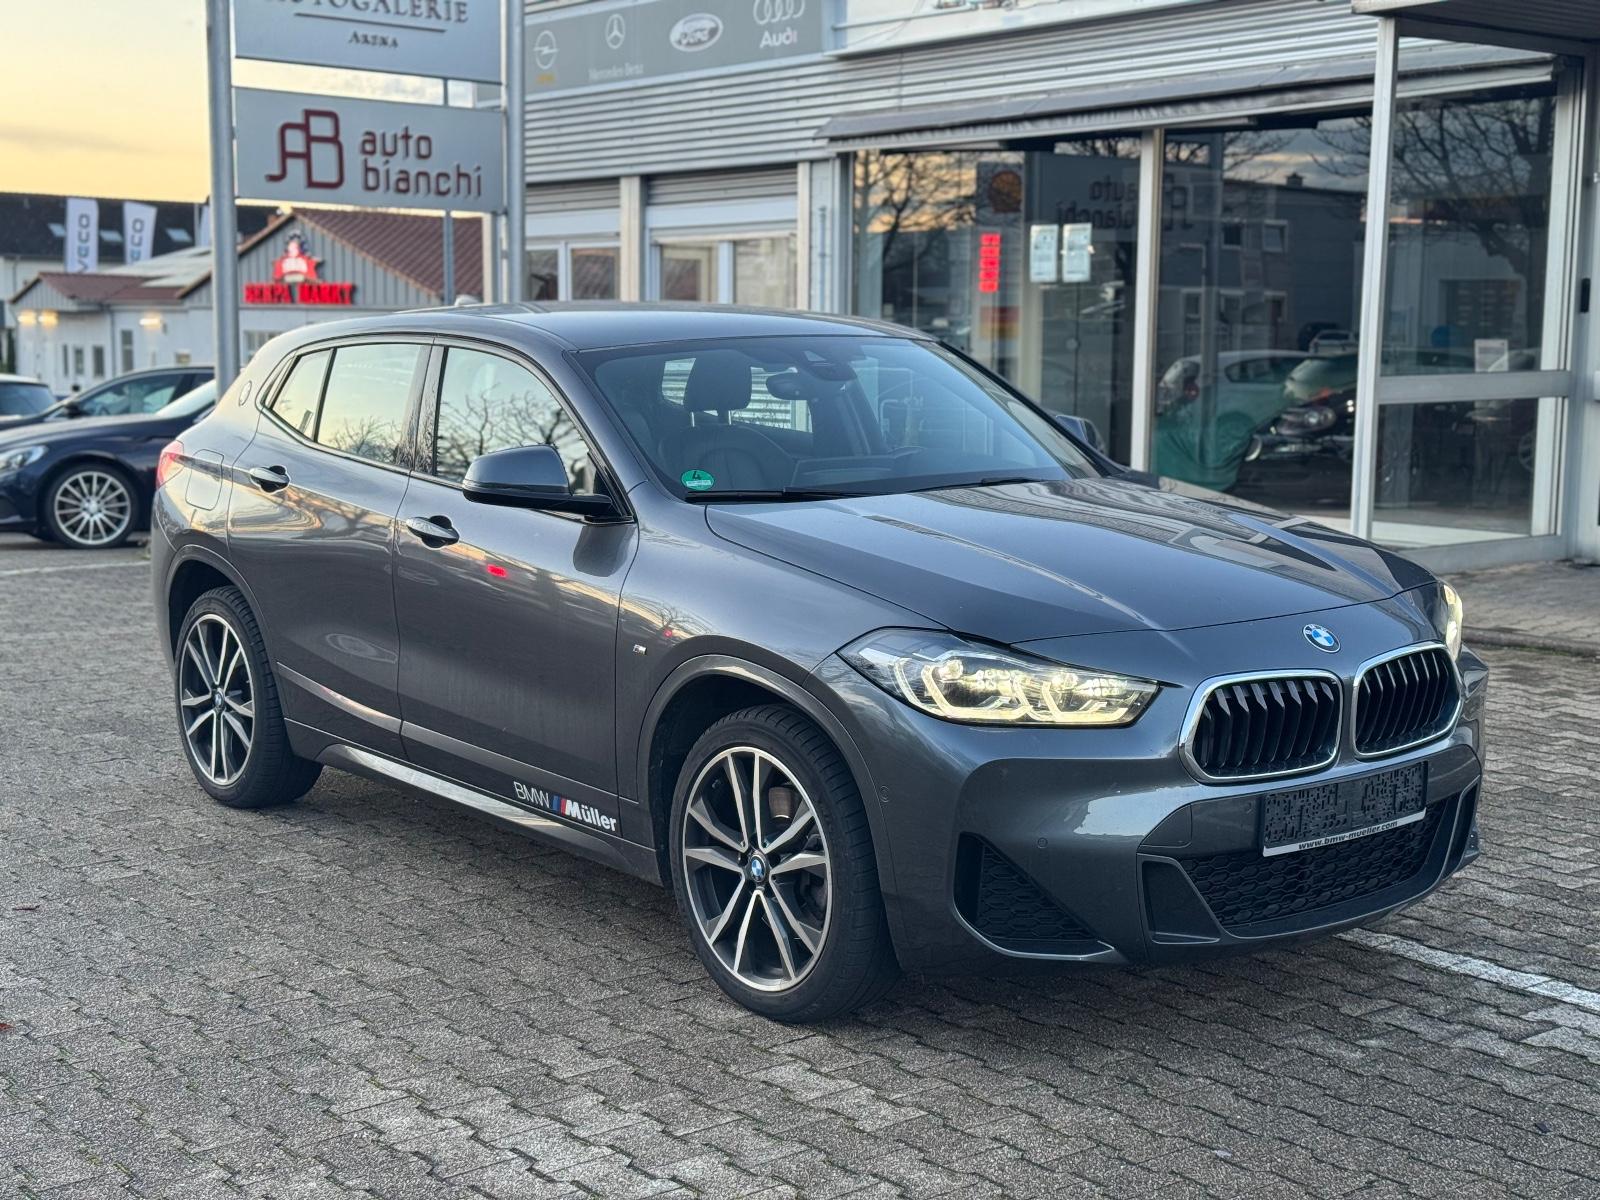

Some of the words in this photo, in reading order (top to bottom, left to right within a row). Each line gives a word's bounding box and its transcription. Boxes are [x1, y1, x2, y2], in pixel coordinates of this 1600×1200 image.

[759, 26, 798, 48] Audi
[360, 126, 432, 160] auto
[362, 158, 482, 198] bianchi
[513, 781, 550, 809] BMW
[565, 799, 617, 832] Müller
[1298, 820, 1398, 850] www.bmw-mueller.com
